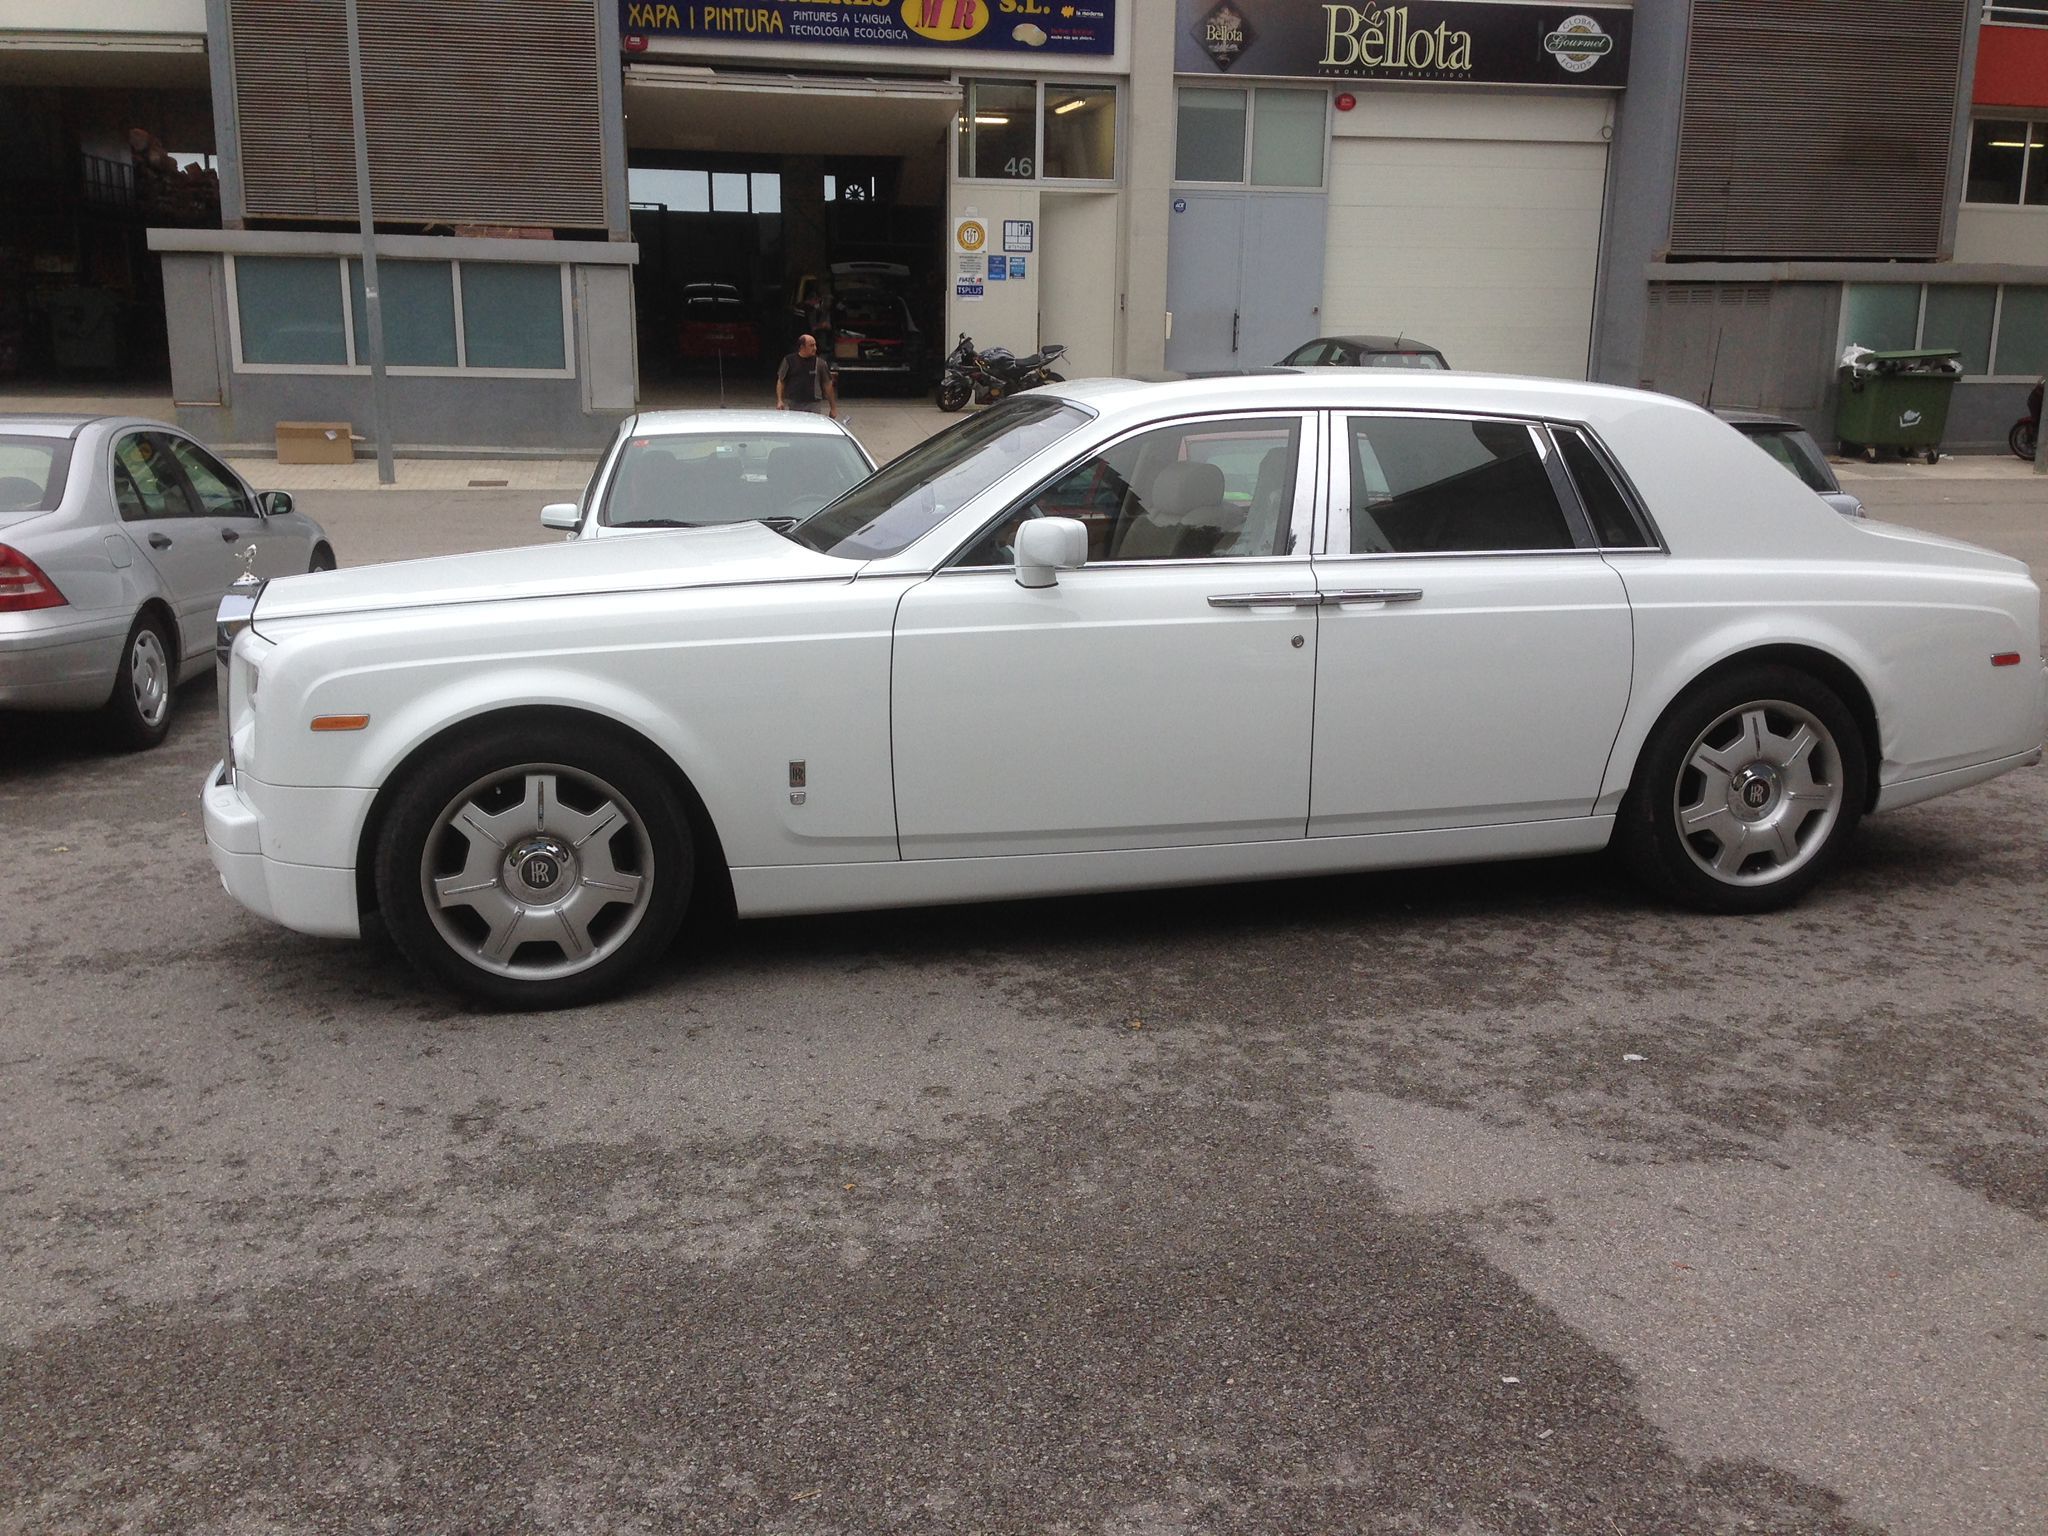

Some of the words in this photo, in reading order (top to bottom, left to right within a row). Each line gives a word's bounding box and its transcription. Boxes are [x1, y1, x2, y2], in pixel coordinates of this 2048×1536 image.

[628, 2, 680, 29] XAPA
[689, 5, 694, 30] I
[704, 6, 784, 34] PINTURA
[793, 10, 838, 23] PINTURES
[842, 13, 850, 23] A
[854, 13, 892, 25] L'AIGUA
[1562, 17, 1596, 30] GLOBAL
[790, 24, 850, 37] TECNOLOGIA
[854, 27, 908, 40] ECOLÒGICA
[1206, 24, 1243, 42] Bellota
[1319, 4, 1472, 70] Bellota
[1549, 34, 1606, 50] Gourmet
[1560, 58, 1593, 71] FOODS
[1003, 157, 1033, 177] 46
